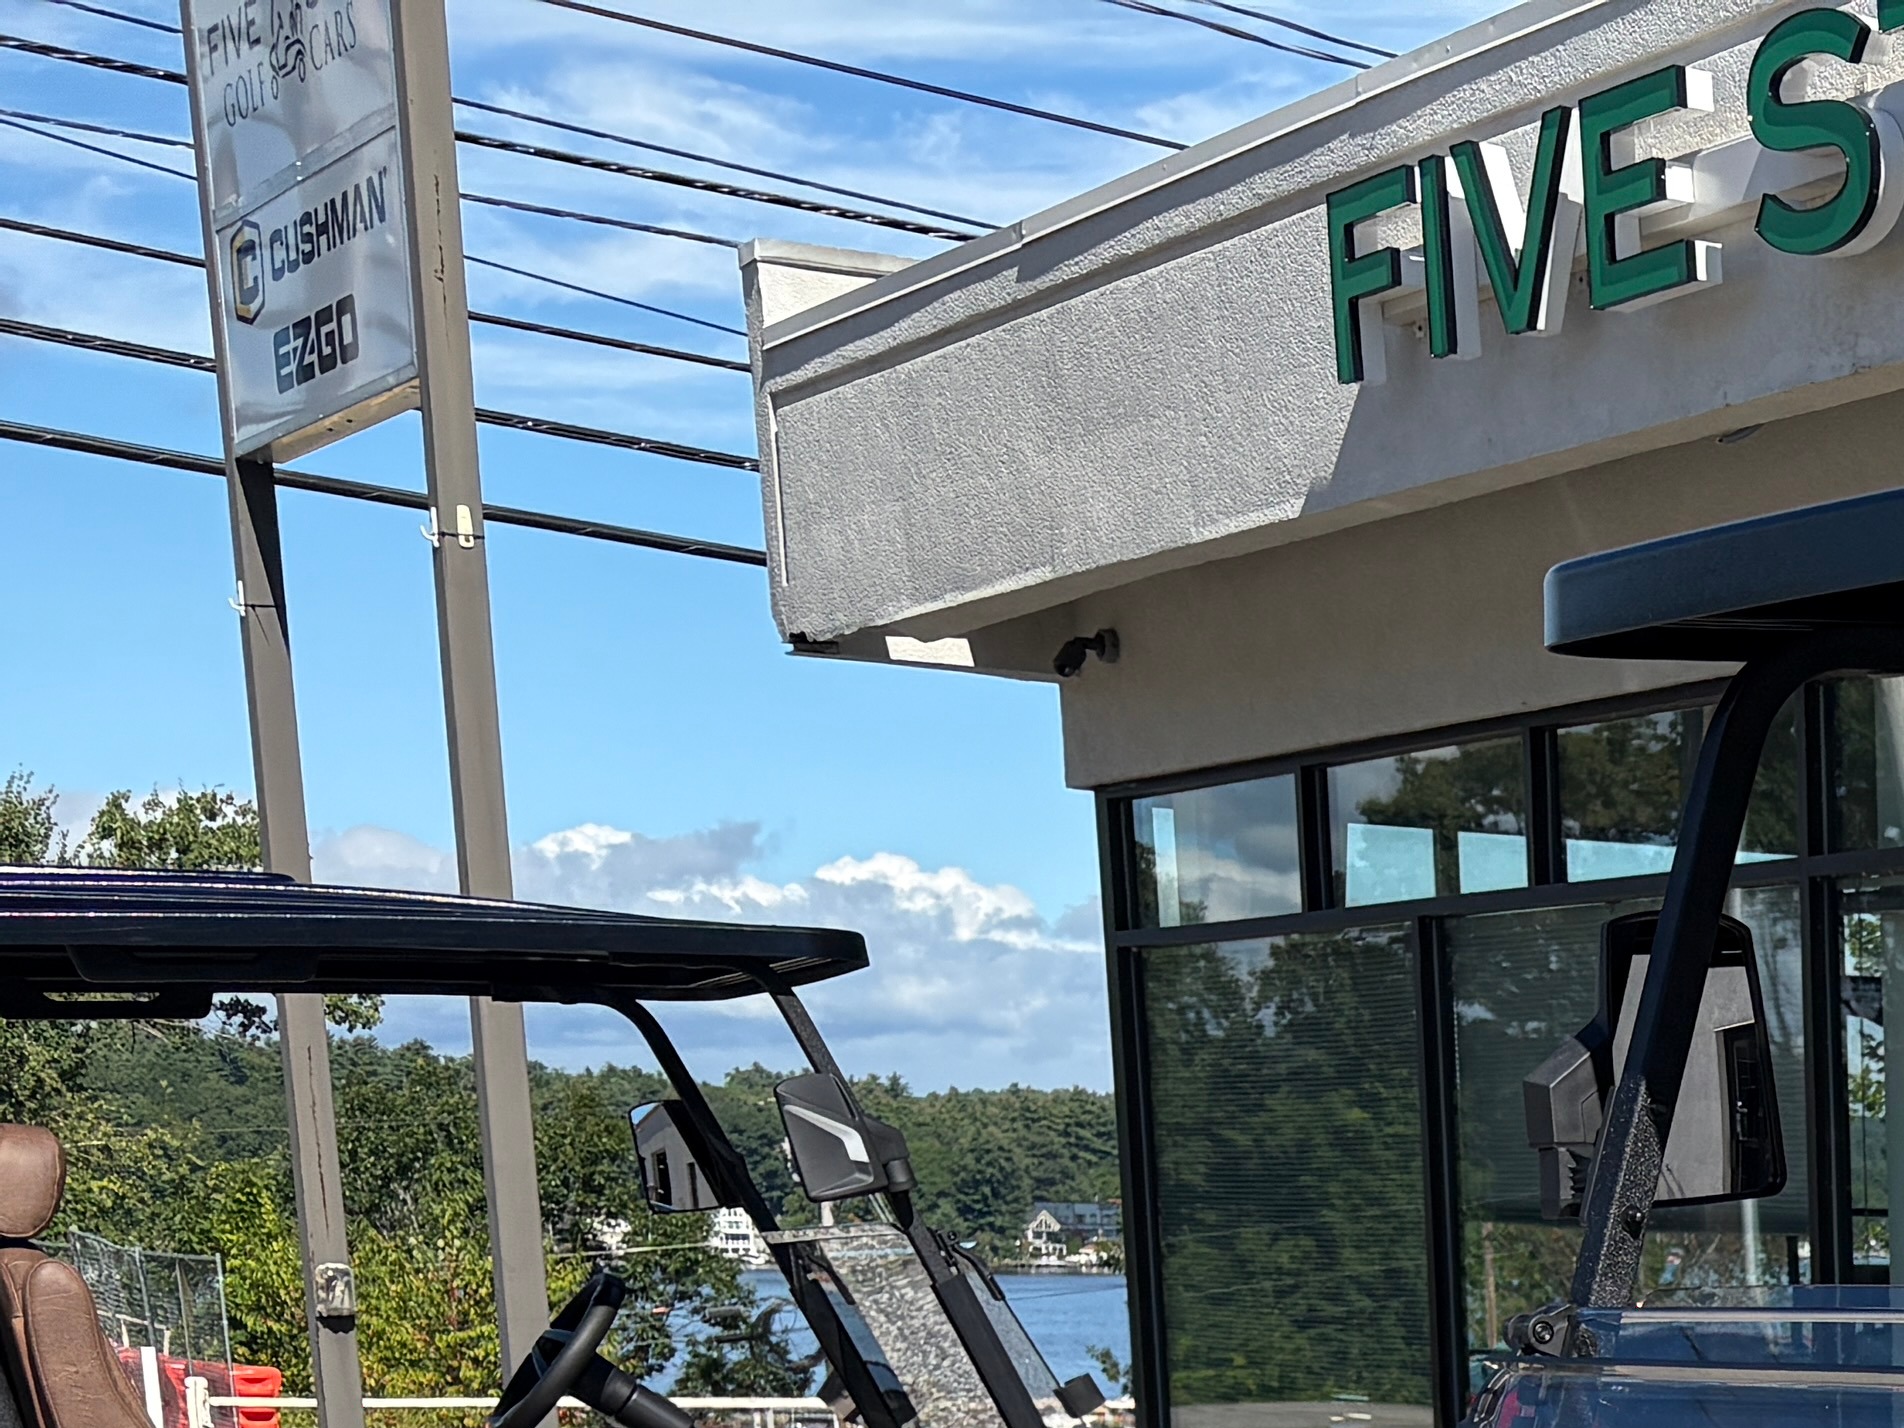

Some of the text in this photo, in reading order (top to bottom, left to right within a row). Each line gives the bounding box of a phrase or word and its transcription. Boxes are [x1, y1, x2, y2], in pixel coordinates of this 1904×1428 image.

[206, 0, 262, 77] FIVE
[224, 2, 357, 127] GOLF CARS
[269, 173, 387, 282] CUSHMAN
[1327, 64, 1698, 384] FIVE
[273, 293, 359, 394] EZGO
